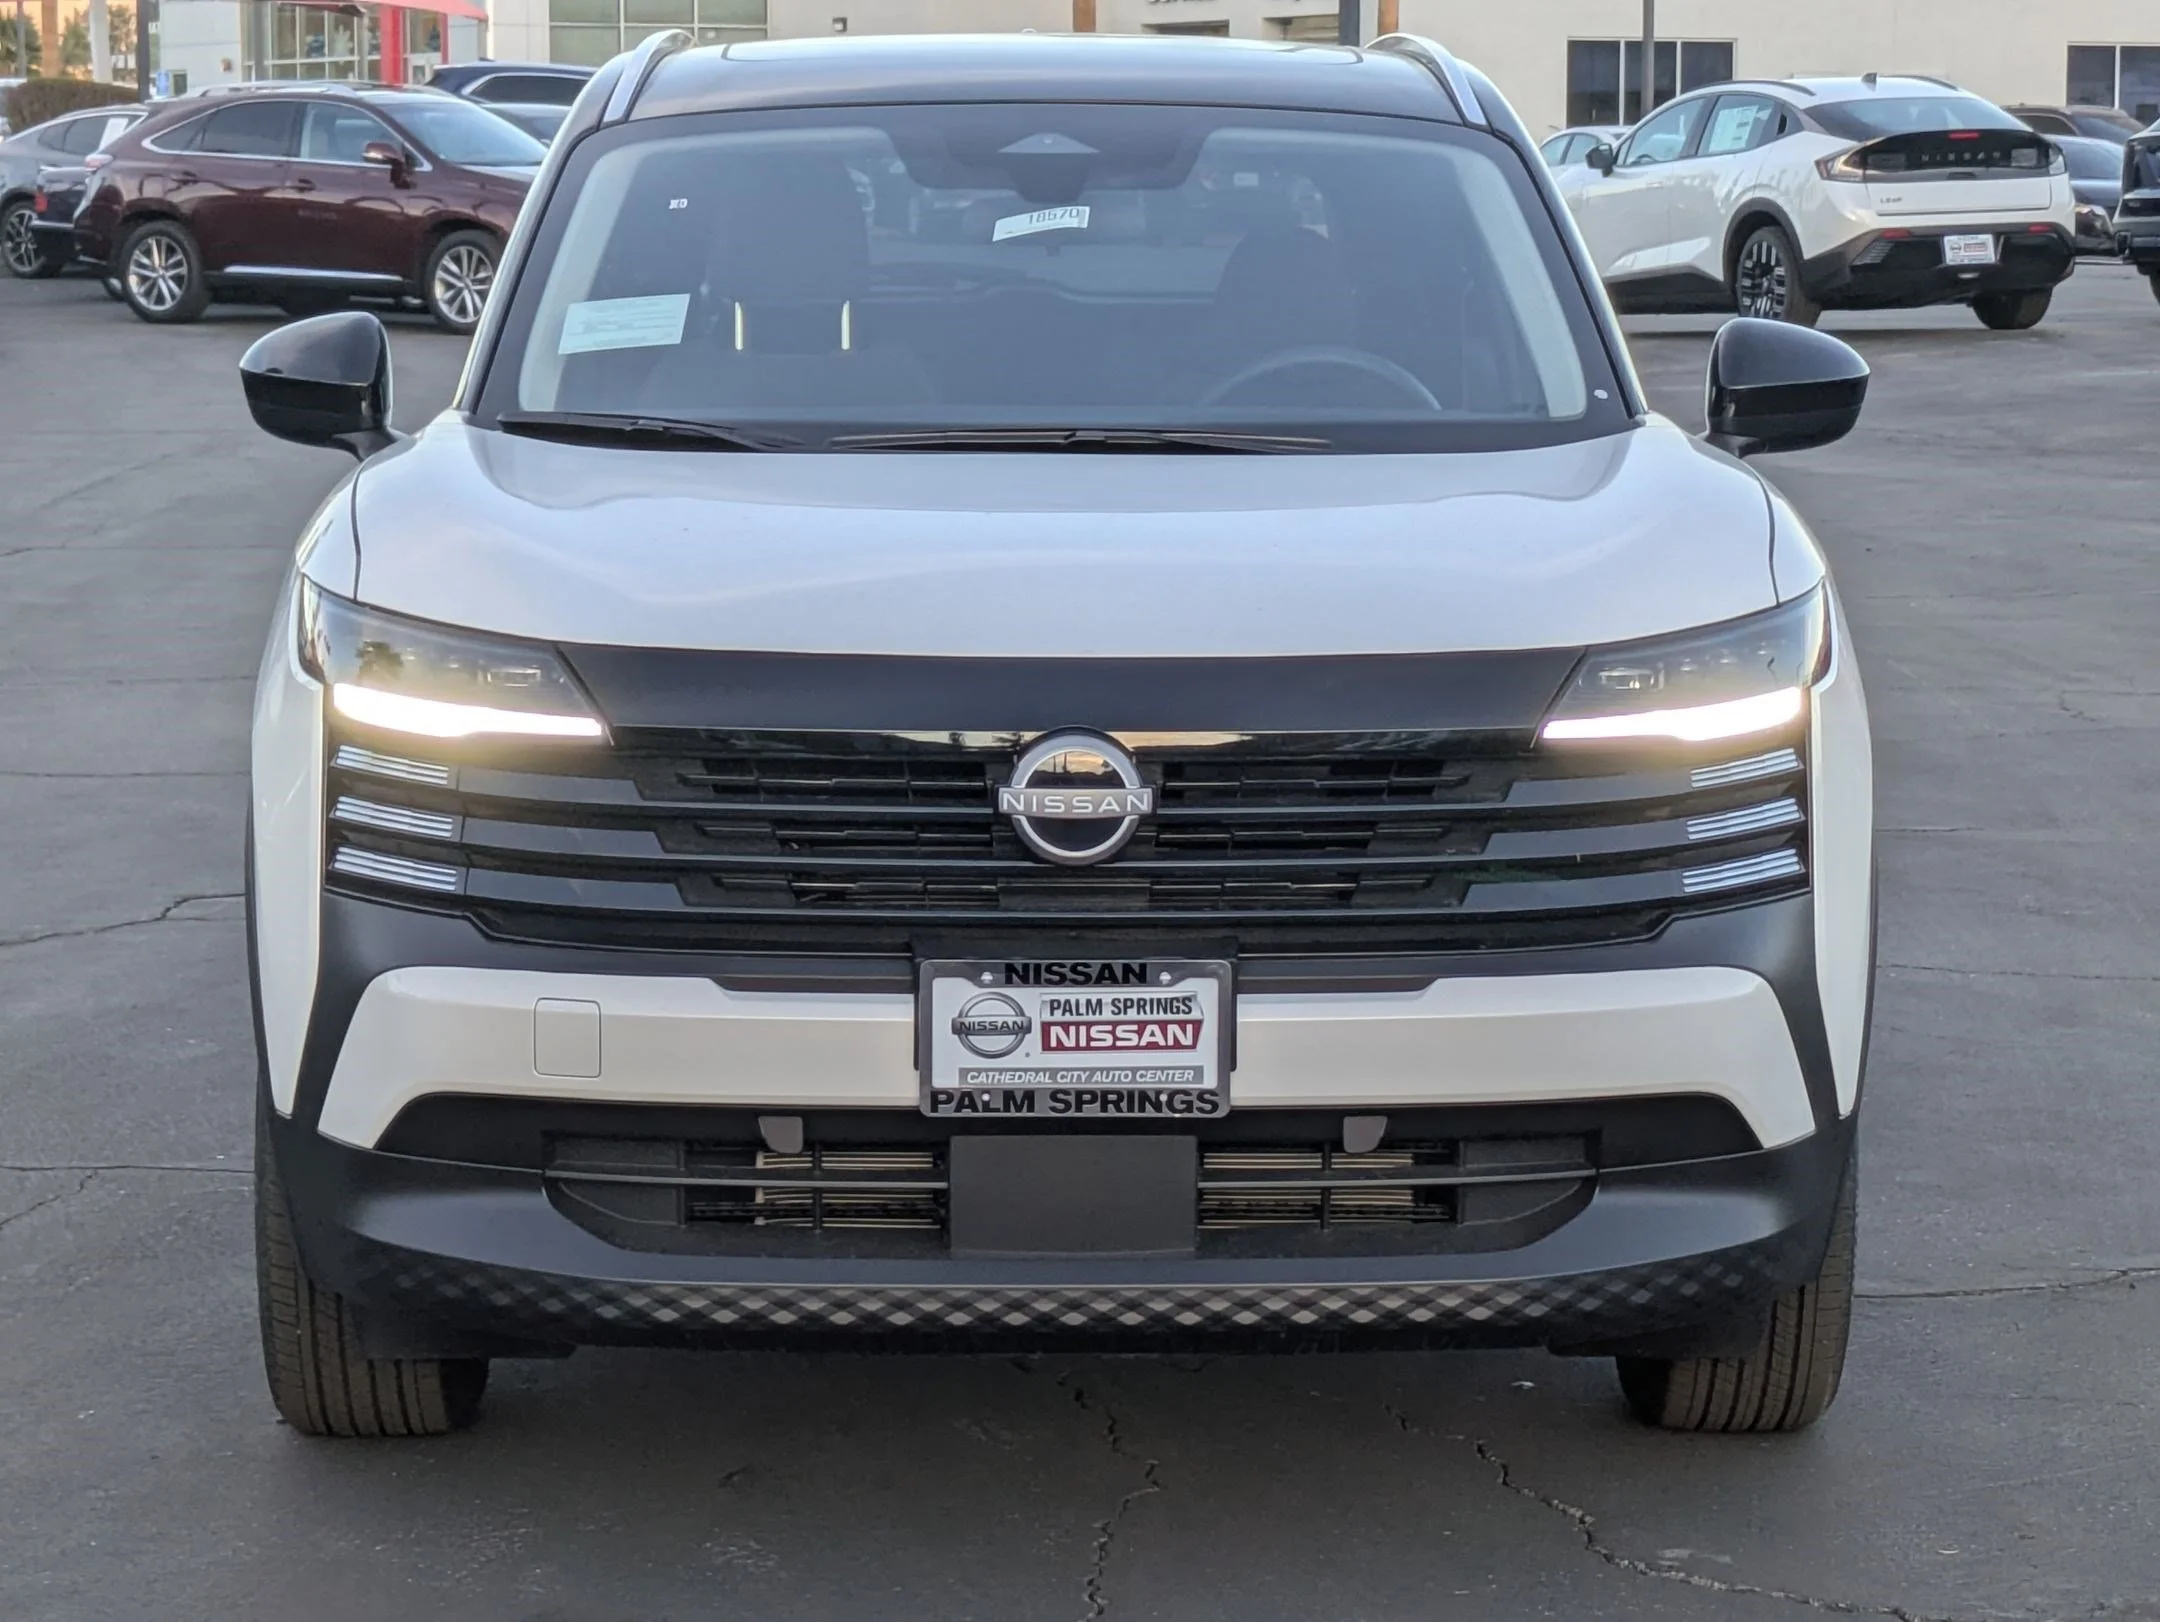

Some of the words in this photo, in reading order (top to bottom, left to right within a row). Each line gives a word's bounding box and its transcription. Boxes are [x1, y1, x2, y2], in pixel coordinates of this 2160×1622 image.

[1003, 793, 1148, 813] NISSAN
[1004, 962, 1147, 986] NISSAN
[1049, 998, 1103, 1017] PALM
[1110, 997, 1193, 1016] SPRINGS
[959, 1020, 1024, 1032] NISSAN
[1049, 1024, 1193, 1048] NISSAN
[967, 1071, 1053, 1085] CATHEDRAL
[1057, 1070, 1090, 1084] CITY
[1092, 1070, 1132, 1083] AUTO
[1136, 1069, 1194, 1083] CENTER
[930, 1089, 1035, 1114] PALM
[1048, 1088, 1220, 1115] SPRINGS
